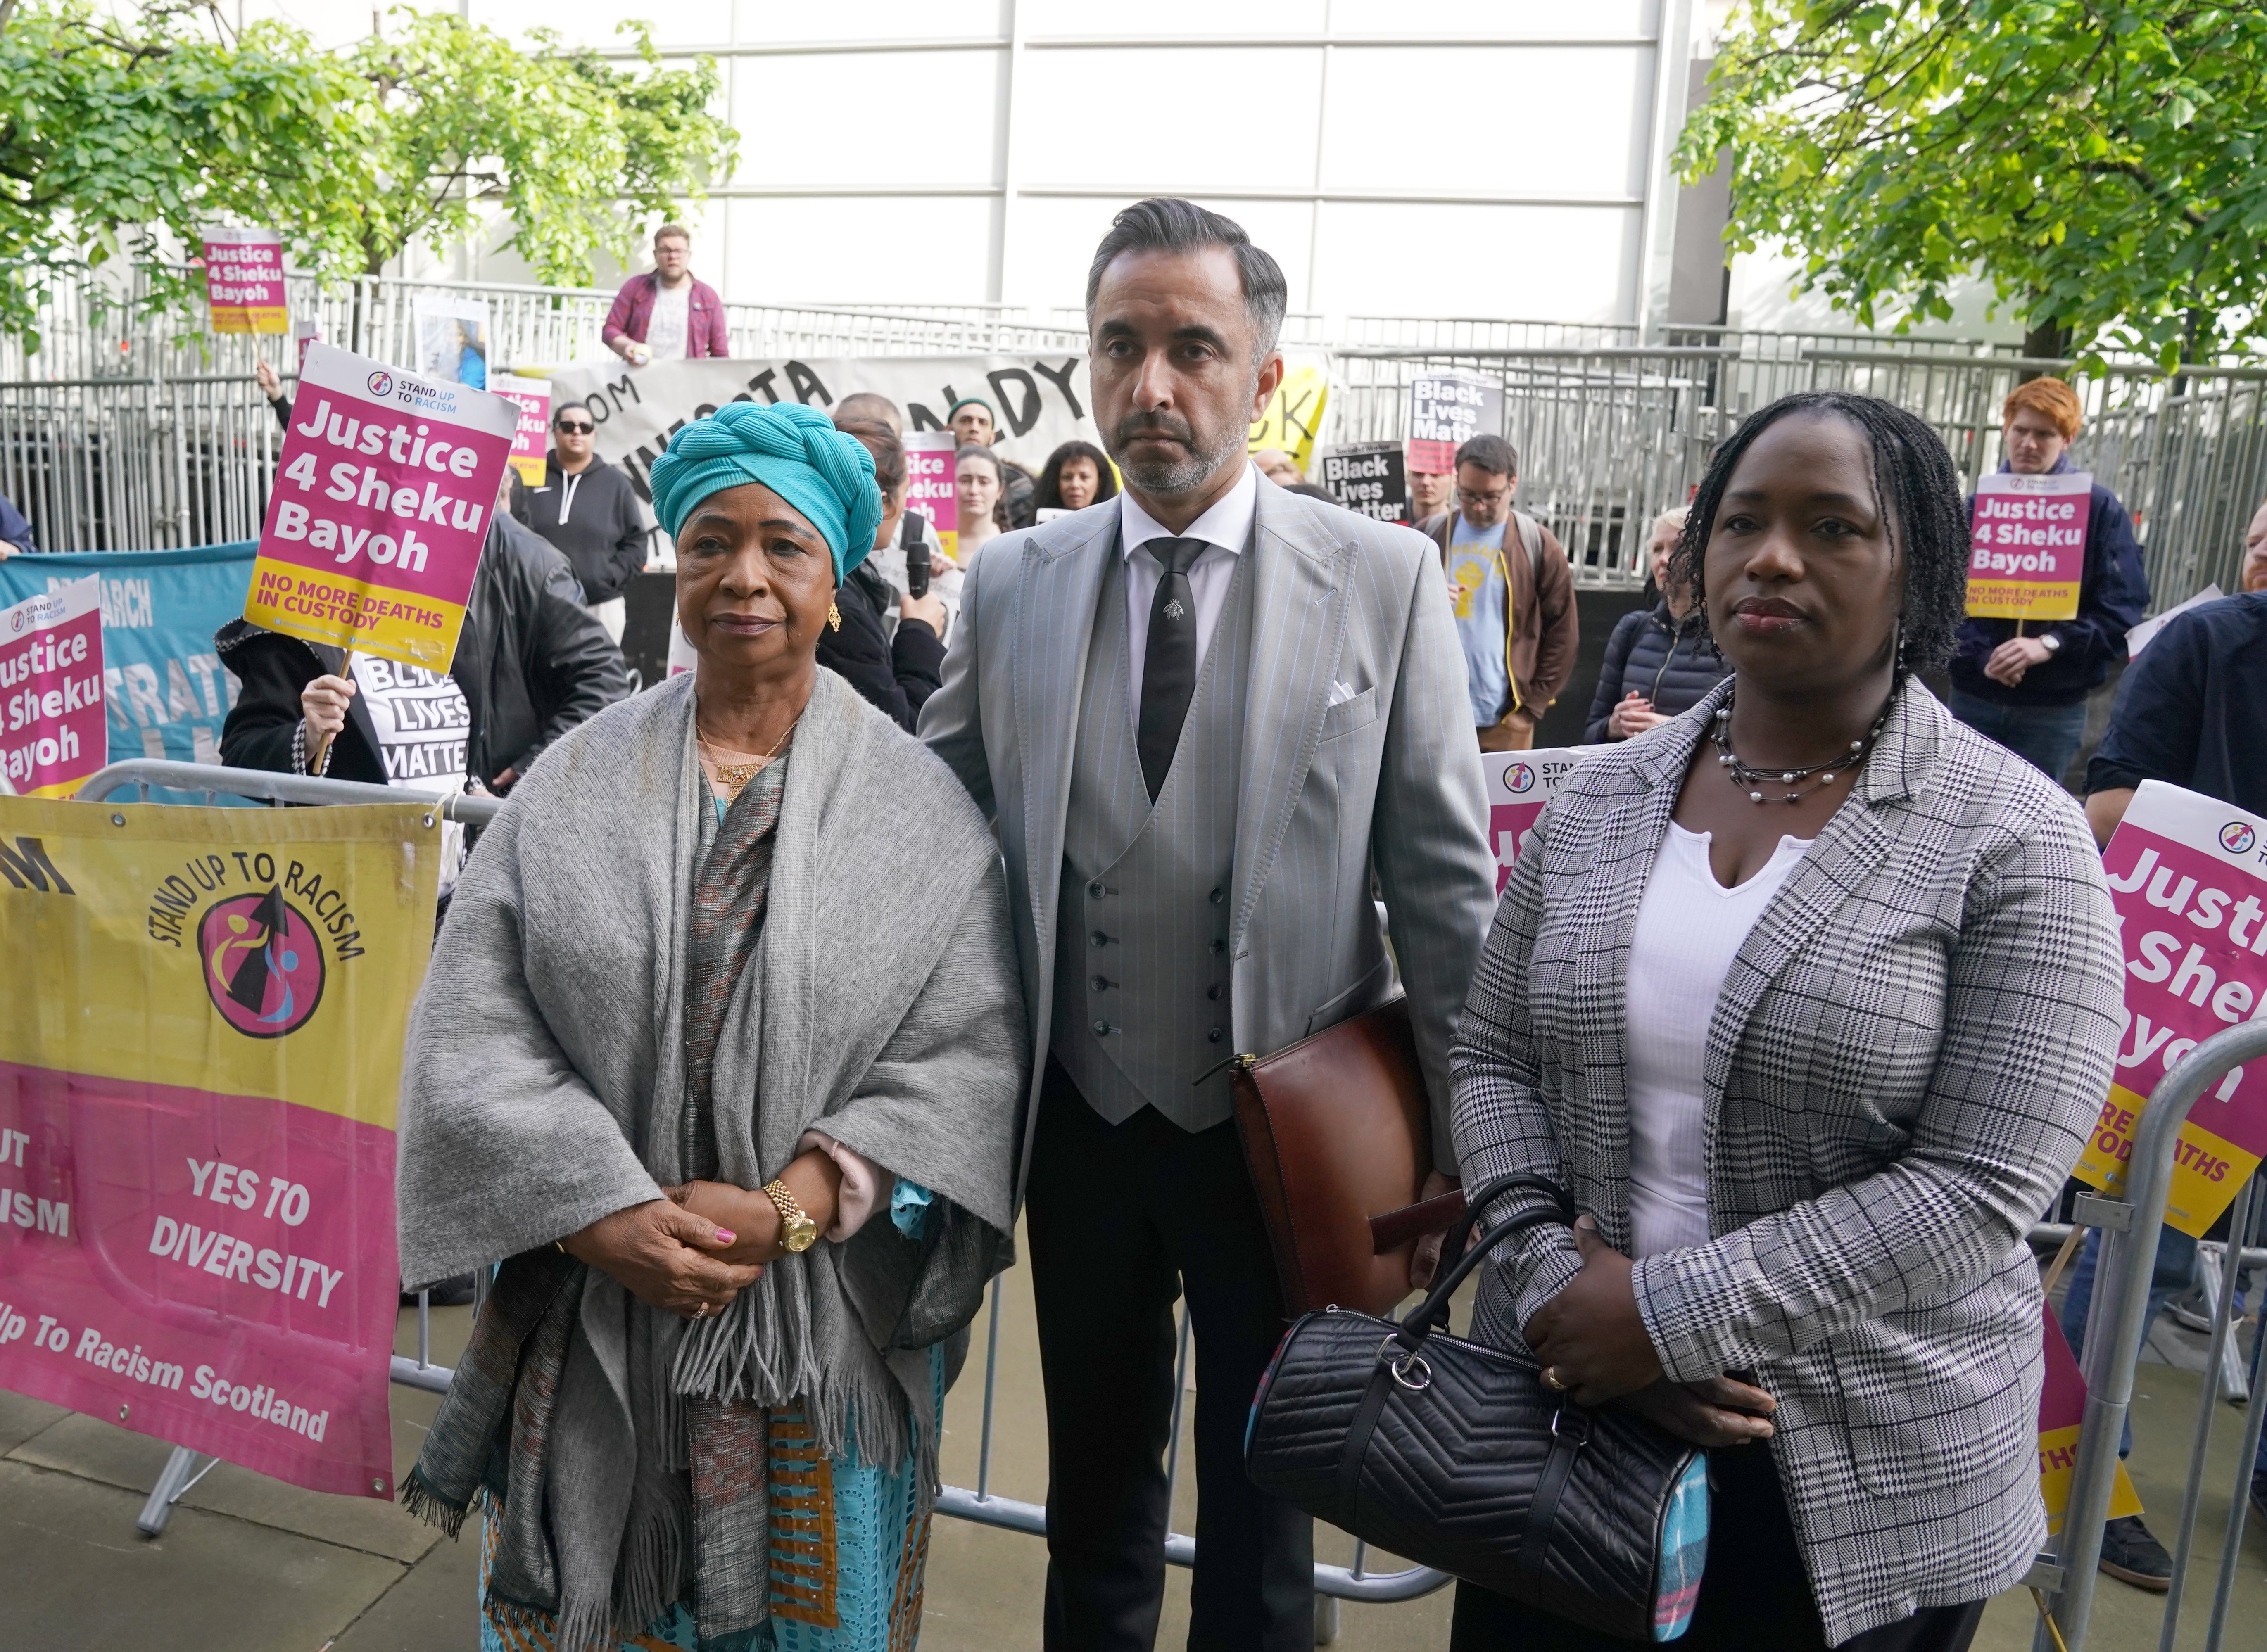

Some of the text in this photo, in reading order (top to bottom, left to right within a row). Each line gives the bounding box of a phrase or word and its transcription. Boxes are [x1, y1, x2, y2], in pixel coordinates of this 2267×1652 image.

[207, 245, 273, 263] Justice
[209, 264, 282, 282] 4 Sheku
[211, 284, 269, 304] Bayoh
[398, 392, 457, 414] TO RACISM
[399, 380, 455, 401] STAND UP
[585, 374, 642, 424] OM
[1414, 380, 1484, 407] Black
[1414, 399, 1477, 424] Lives
[297, 399, 478, 478] Justice
[1413, 418, 1484, 442] Matt
[1326, 454, 1389, 481] Black
[285, 453, 484, 534] 4 Sheku
[1977, 498, 2075, 520] Justice
[274, 500, 428, 572] Bayoh
[1975, 523, 2082, 546] 4 Sheku
[1972, 549, 2056, 575] Bayoh
[260, 572, 292, 592] NO
[297, 581, 359, 609] MORE
[363, 598, 444, 630] DEATHS
[1982, 596, 2033, 606] CUSTODY
[1989, 587, 2021, 596] MORE
[2024, 589, 2069, 598] DEATHS
[26, 598, 63, 615] STAND UP
[27, 607, 66, 624] TO RACISM
[257, 589, 278, 608] IN
[284, 596, 380, 631] CUSTODY
[8, 674, 100, 731] Sheku
[394, 695, 471, 730] LIVES
[381, 740, 467, 778] MATTE
[1542, 763, 1574, 774] STA
[148, 852, 365, 962] STAND UP TO RACISM
[2098, 1100, 2135, 1134] RE
[186, 1158, 310, 1227] YES TO
[0, 1188, 69, 1237] ISM
[148, 1215, 344, 1309] DIVERSITY
[34, 1314, 70, 1352] To
[75, 1327, 184, 1391] Racism
[189, 1365, 329, 1444] Scotland
